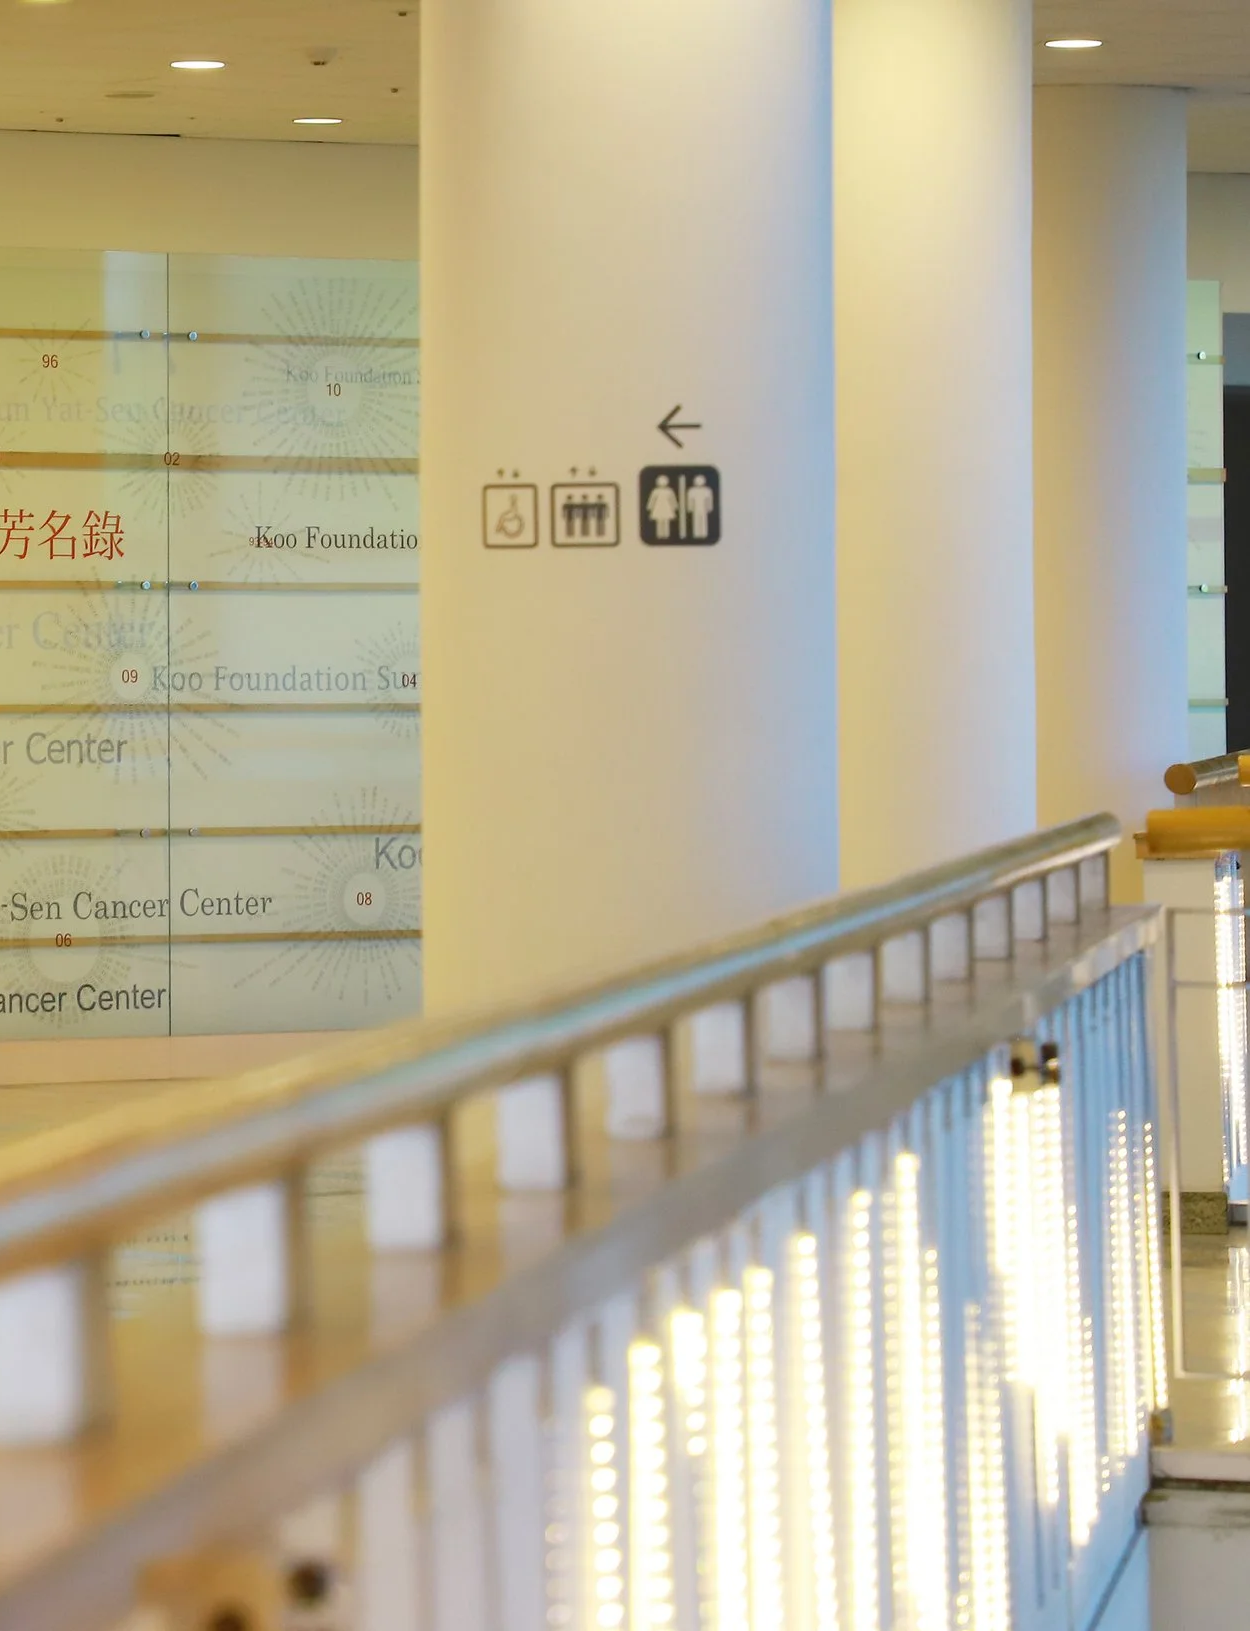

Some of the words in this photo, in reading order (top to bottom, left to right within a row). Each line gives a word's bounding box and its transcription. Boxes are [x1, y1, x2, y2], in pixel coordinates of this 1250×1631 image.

[41, 354, 59, 369] 96
[326, 383, 342, 397] 10
[164, 452, 181, 467] 02
[254, 525, 297, 549] Koo
[121, 669, 138, 683] 09
[151, 664, 203, 692] Koo
[214, 665, 367, 692] Foundation
[402, 673, 417, 688] 04
[26, 731, 127, 764] Center
[374, 836, 422, 870] Ko
[73, 890, 170, 921] Cancer
[180, 888, 273, 918] Center
[356, 892, 373, 907] 08
[55, 934, 72, 948] 06
[76, 983, 167, 1013] Center
